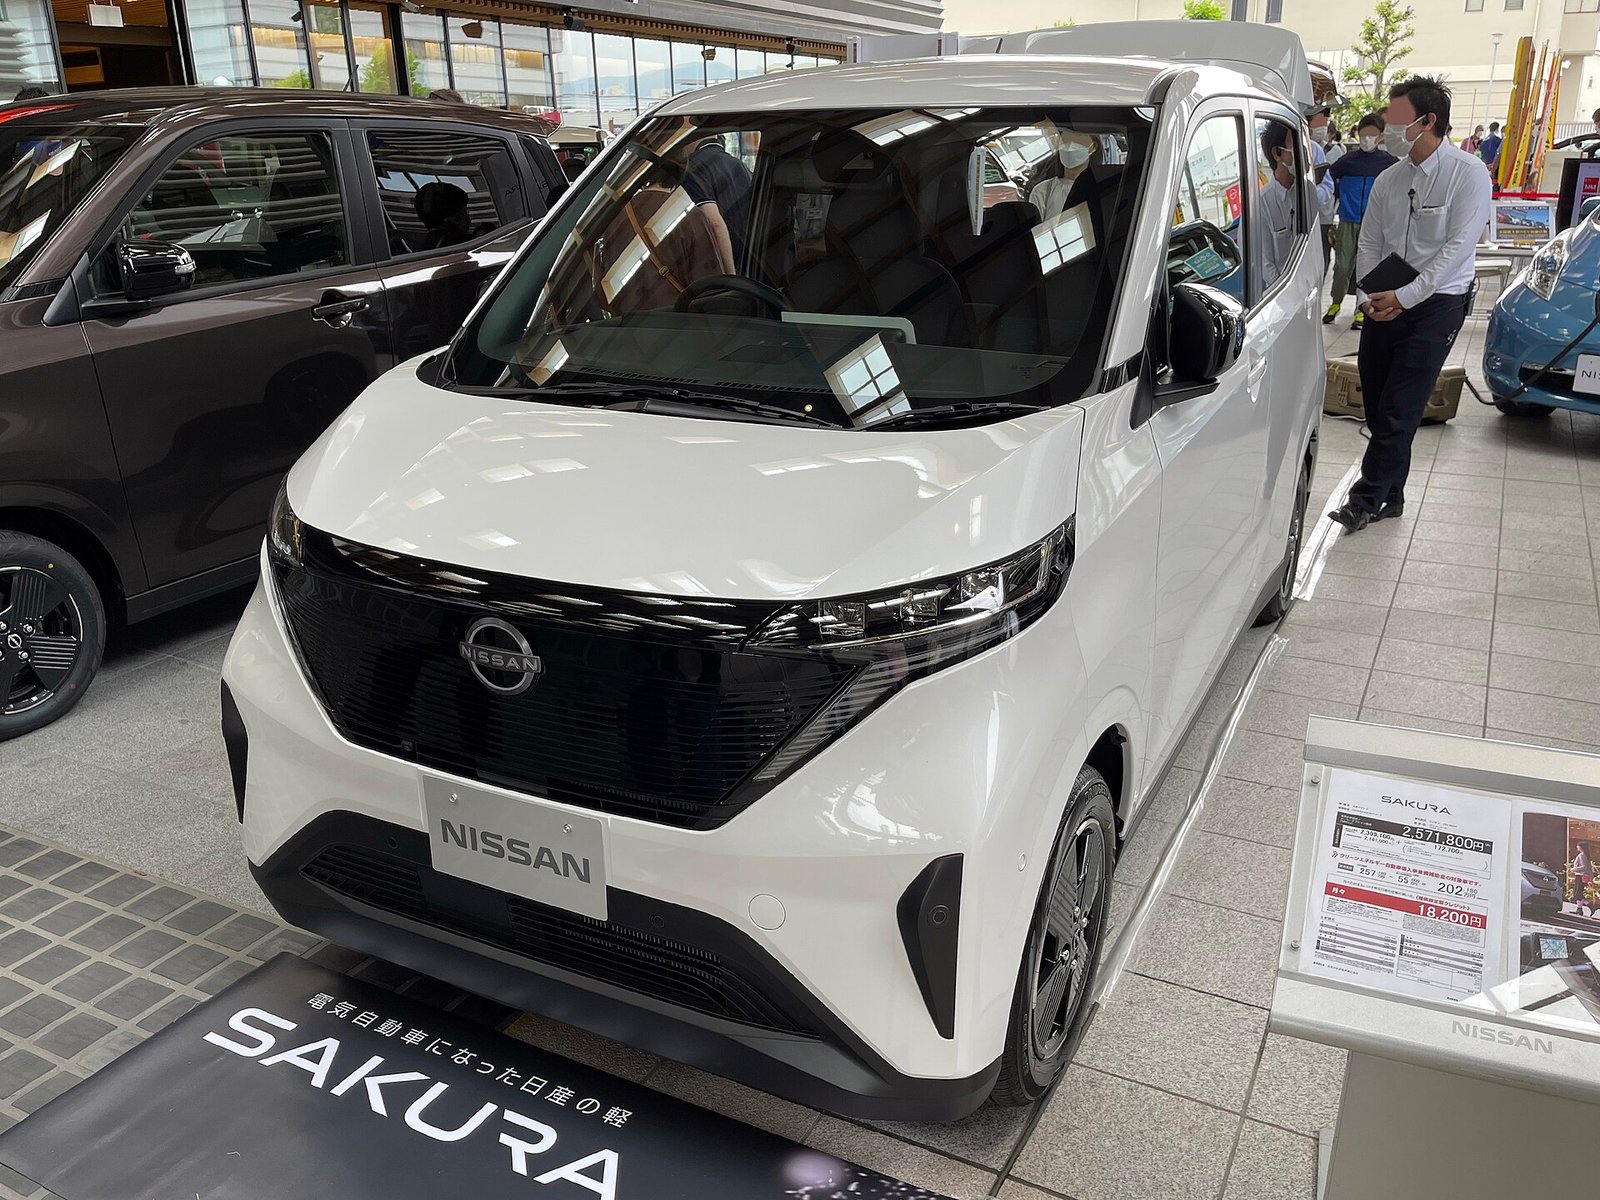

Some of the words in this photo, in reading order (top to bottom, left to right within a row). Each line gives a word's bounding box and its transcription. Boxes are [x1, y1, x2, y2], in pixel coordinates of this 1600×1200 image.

[460, 644, 540, 672] NISSAN
[1381, 795, 1452, 816] SAKURA
[440, 818, 591, 884] NISSAN
[1402, 826, 1484, 852] 2,571,800円
[1418, 904, 1482, 928] 18,200円
[1452, 1020, 1553, 1054] NISSAN
[306, 991, 634, 1130] 電気自動車になった日産の軽
[202, 1007, 620, 1200] SAKURA
